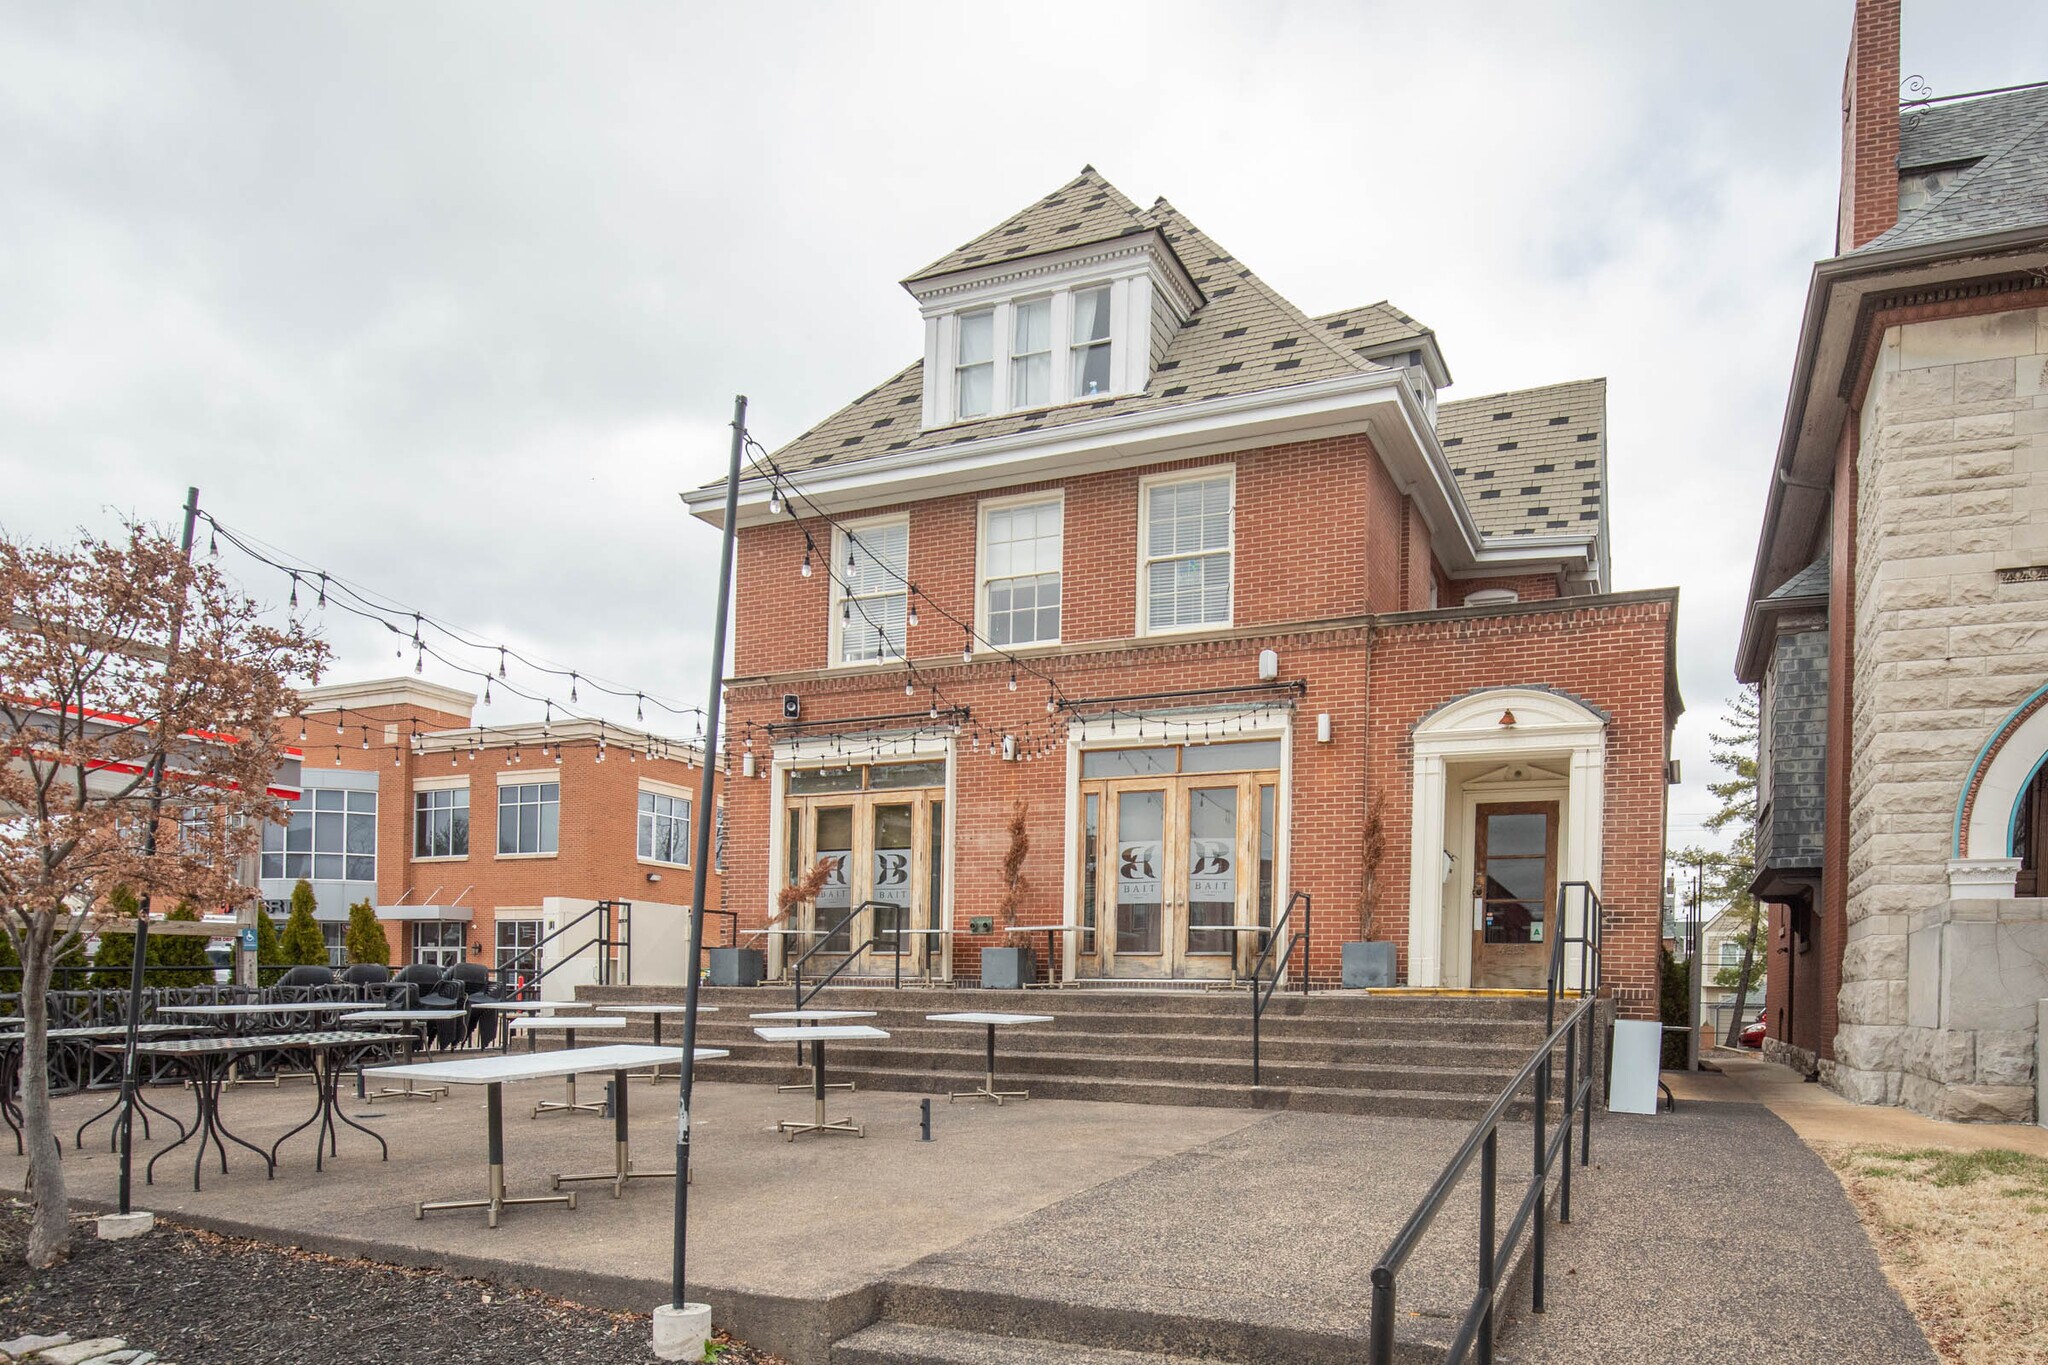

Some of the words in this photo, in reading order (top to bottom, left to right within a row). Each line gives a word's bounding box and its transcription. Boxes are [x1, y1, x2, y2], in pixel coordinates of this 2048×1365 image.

[1123, 884, 1155, 893] BAIT
[1194, 881, 1228, 890] BAIT
[879, 890, 907, 899] BAIT
